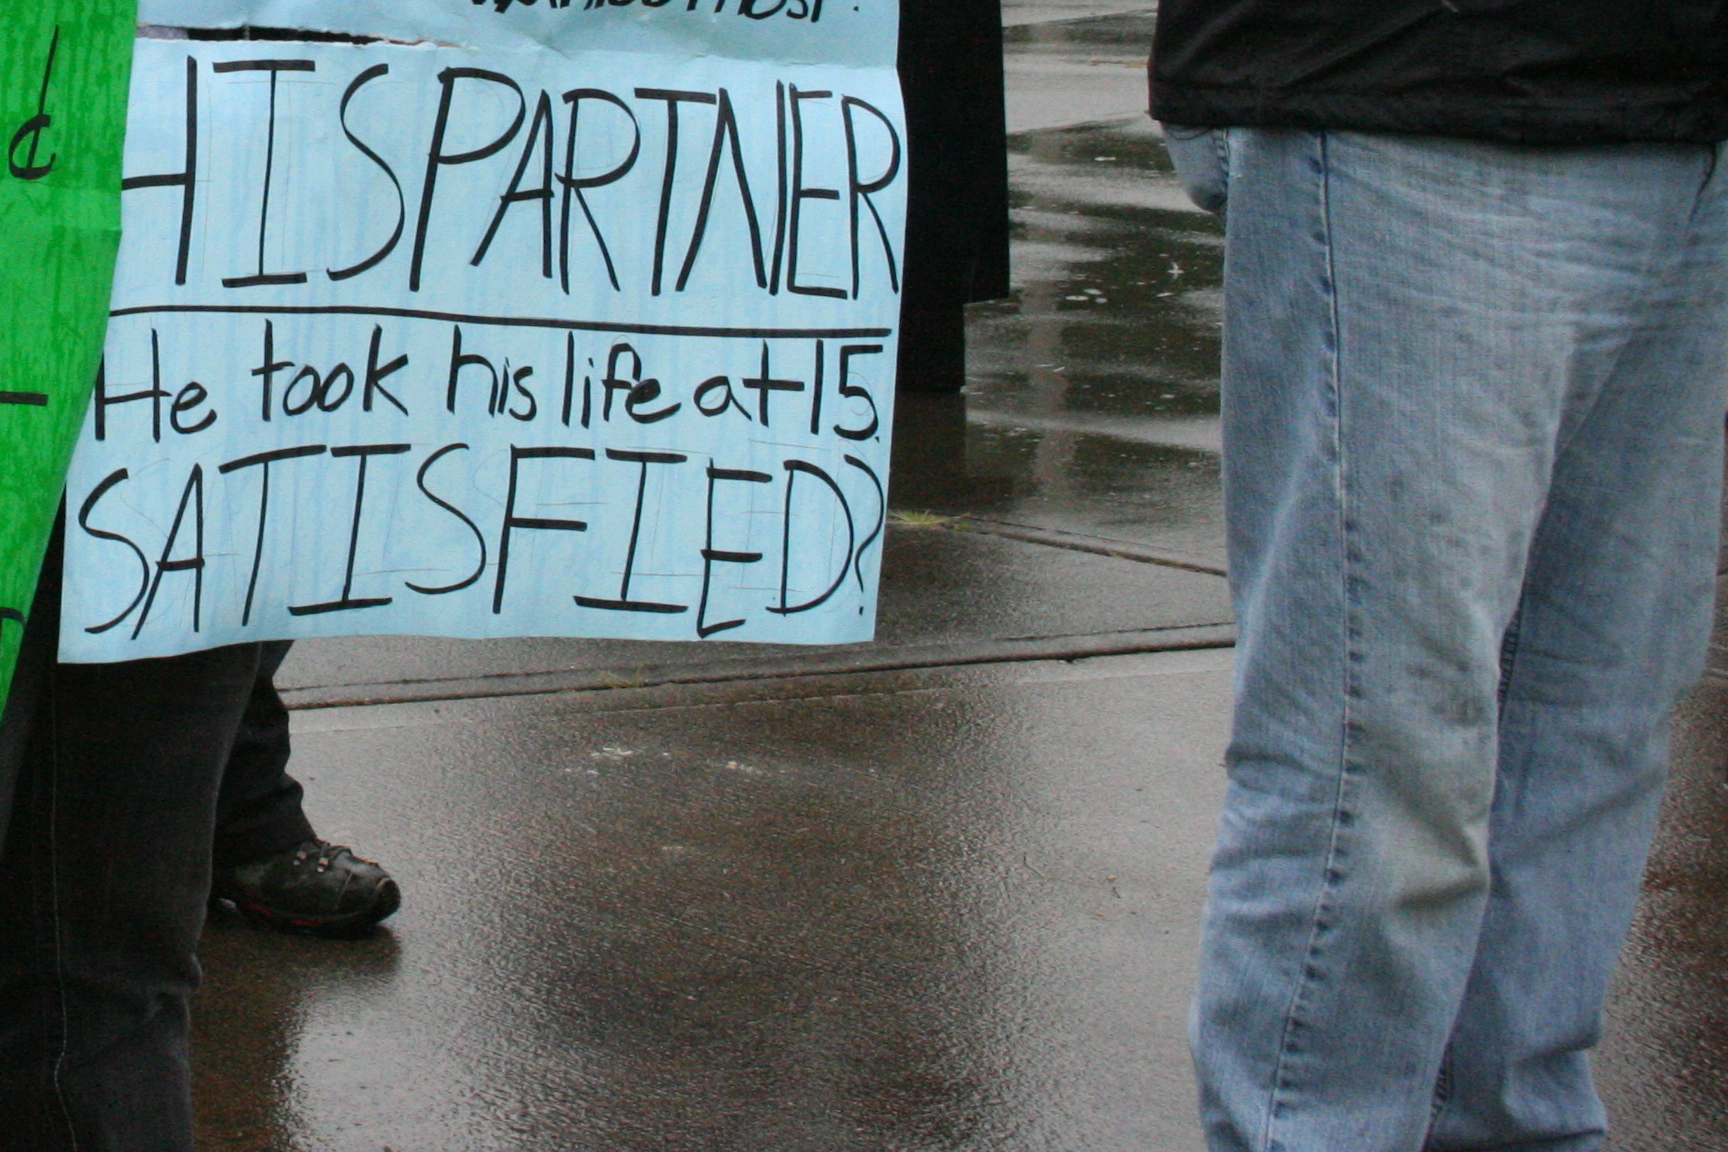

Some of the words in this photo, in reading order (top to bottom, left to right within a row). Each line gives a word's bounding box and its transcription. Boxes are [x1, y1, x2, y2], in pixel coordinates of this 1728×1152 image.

[122, 54, 407, 289] HIS
[409, 65, 902, 300] PARTNER
[94, 327, 218, 445] He
[251, 318, 410, 424] took
[447, 323, 539, 424] his
[562, 330, 682, 431] life
[693, 338, 806, 428] at
[77, 441, 886, 641] SATISFIED?
